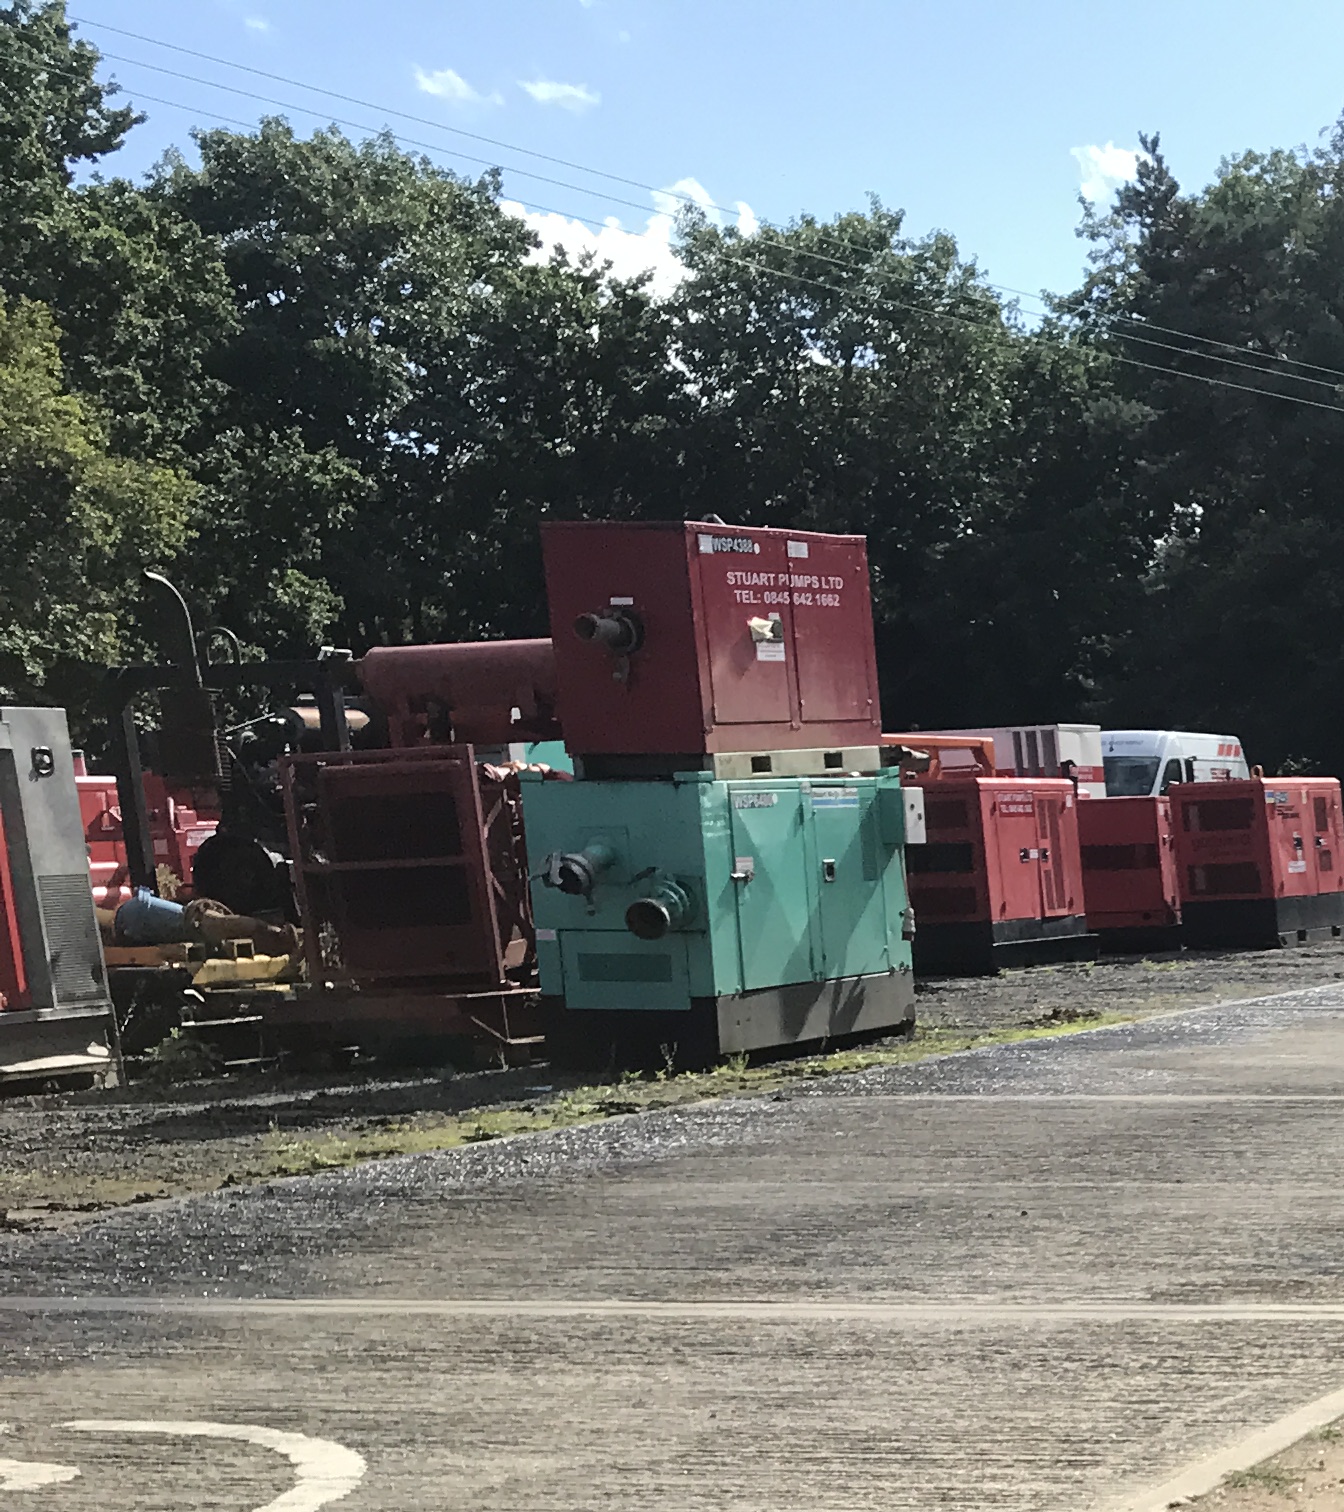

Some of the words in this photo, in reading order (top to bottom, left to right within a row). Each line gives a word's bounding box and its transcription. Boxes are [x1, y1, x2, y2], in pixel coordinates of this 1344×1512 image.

[726, 571, 775, 586] STUART
[778, 574, 819, 589] PUMPS
[821, 576, 844, 589] LTD
[734, 589, 761, 604] TEL:
[764, 591, 790, 605] 0845
[793, 592, 812, 606] 642
